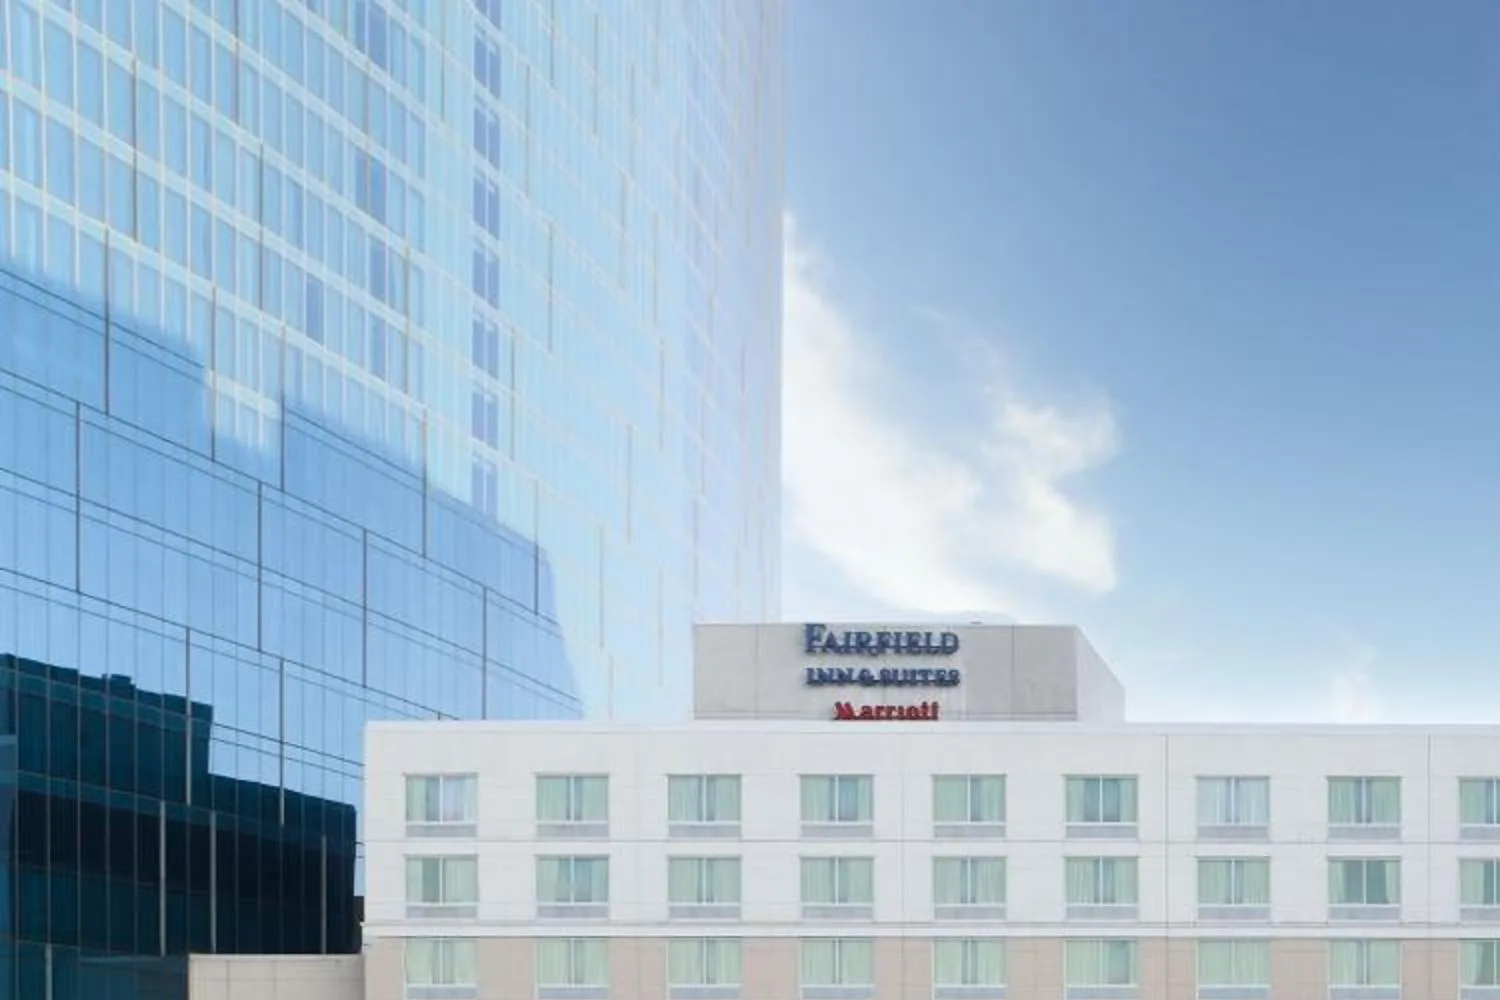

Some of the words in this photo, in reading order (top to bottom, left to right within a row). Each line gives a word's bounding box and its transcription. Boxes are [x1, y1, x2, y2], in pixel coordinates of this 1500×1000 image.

[805, 624, 959, 656] FAIRFIELD
[806, 668, 853, 686] INN
[858, 668, 875, 687] &
[879, 669, 960, 686] SUITES
[834, 702, 939, 720] Marriott
